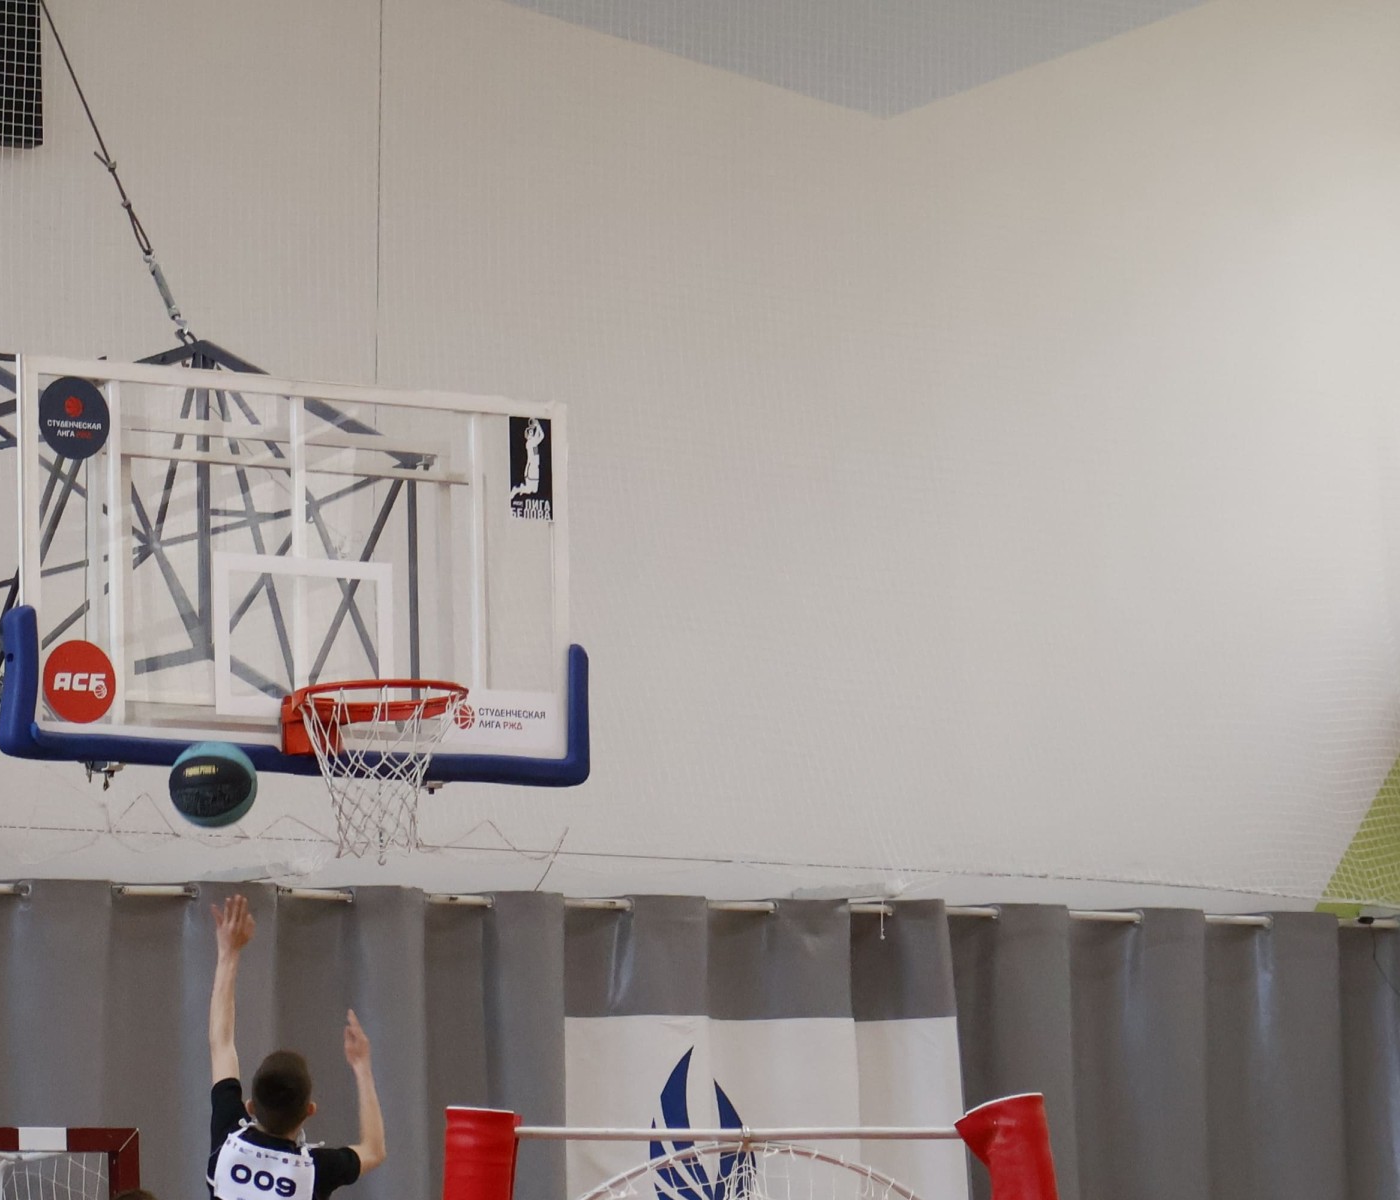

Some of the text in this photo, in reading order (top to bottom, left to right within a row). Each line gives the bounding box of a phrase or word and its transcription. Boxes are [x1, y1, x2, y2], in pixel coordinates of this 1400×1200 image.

[47, 419, 102, 430] СТУДЕНЧЕСКАЯ
[525, 499, 551, 511] ЛИГА
[478, 707, 546, 719] СТУДЕНЧЕСКАЯ
[478, 720, 523, 731] ЛИГА РЖД
[230, 1163, 297, 1198] 009
